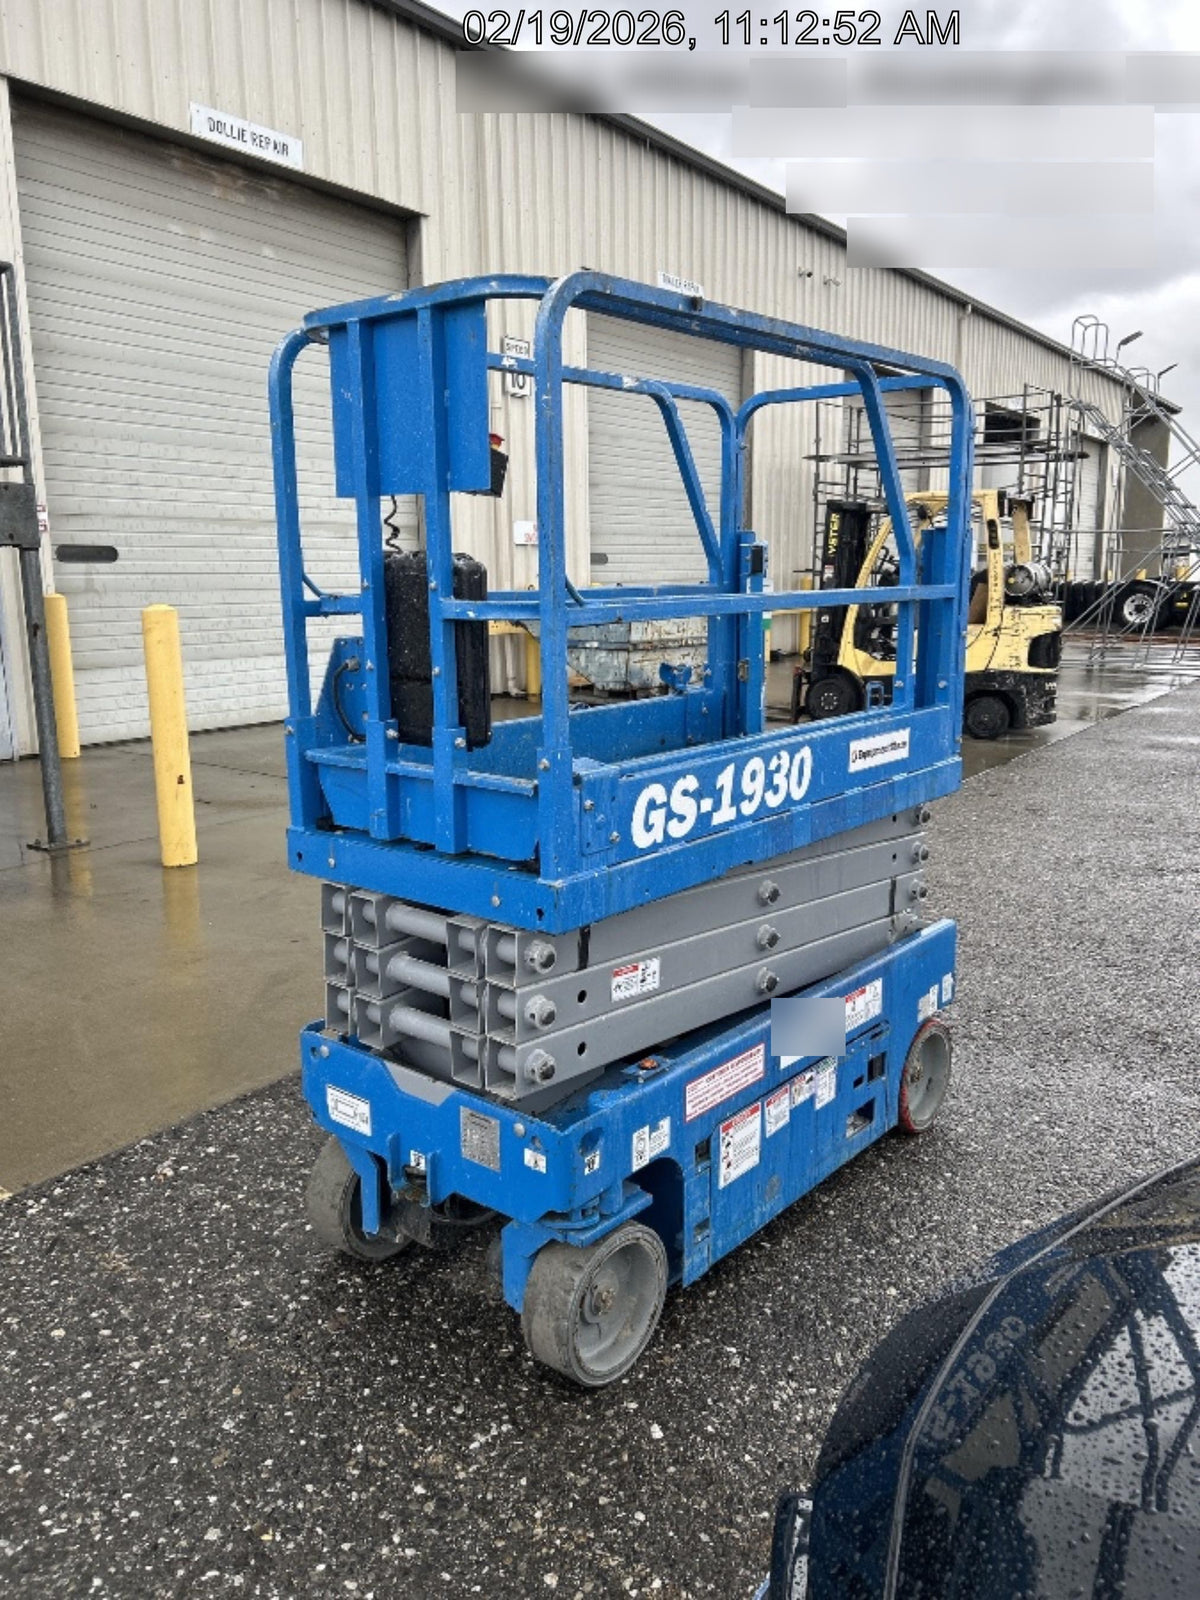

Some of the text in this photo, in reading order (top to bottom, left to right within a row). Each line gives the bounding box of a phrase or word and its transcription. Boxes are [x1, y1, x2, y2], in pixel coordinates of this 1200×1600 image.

[208, 116, 289, 157] DOLLIE REPAIR
[631, 745, 812, 848] GS-1930
